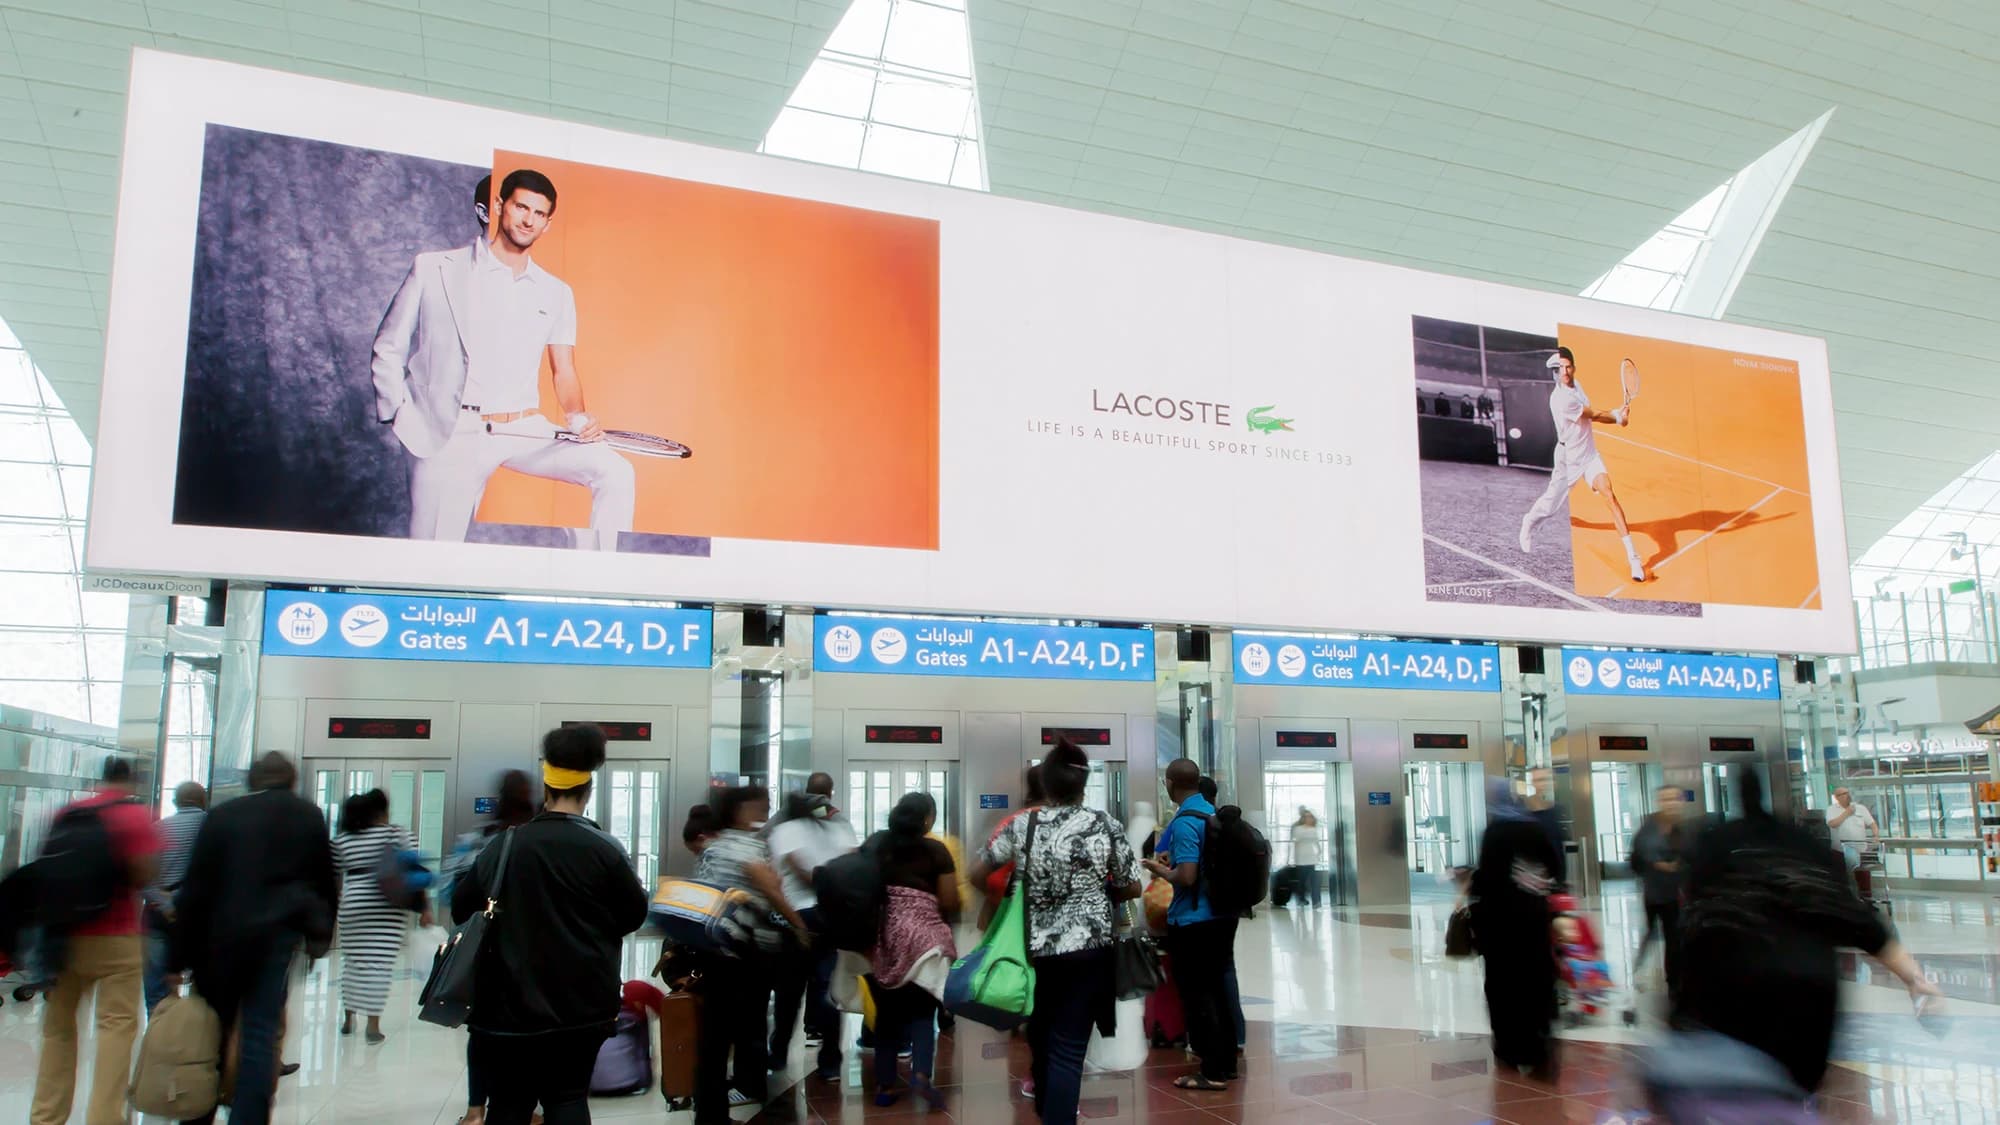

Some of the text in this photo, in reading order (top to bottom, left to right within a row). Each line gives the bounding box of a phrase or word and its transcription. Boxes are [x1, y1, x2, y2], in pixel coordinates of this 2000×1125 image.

[1093, 389, 1231, 426] LACOSTE
[1028, 420, 1352, 466] LIFE IS A BEAUTIFUL SPORT SINCE 1933
[1453, 586, 1493, 598] LACOSTE
[401, 605, 476, 626] البوابات
[400, 630, 466, 650] Gates
[916, 628, 972, 645] البوابات
[916, 649, 967, 666] Gates
[1312, 645, 1356, 660] البوابات
[1313, 664, 1353, 679] Gates
[1627, 675, 1660, 689] Gates
